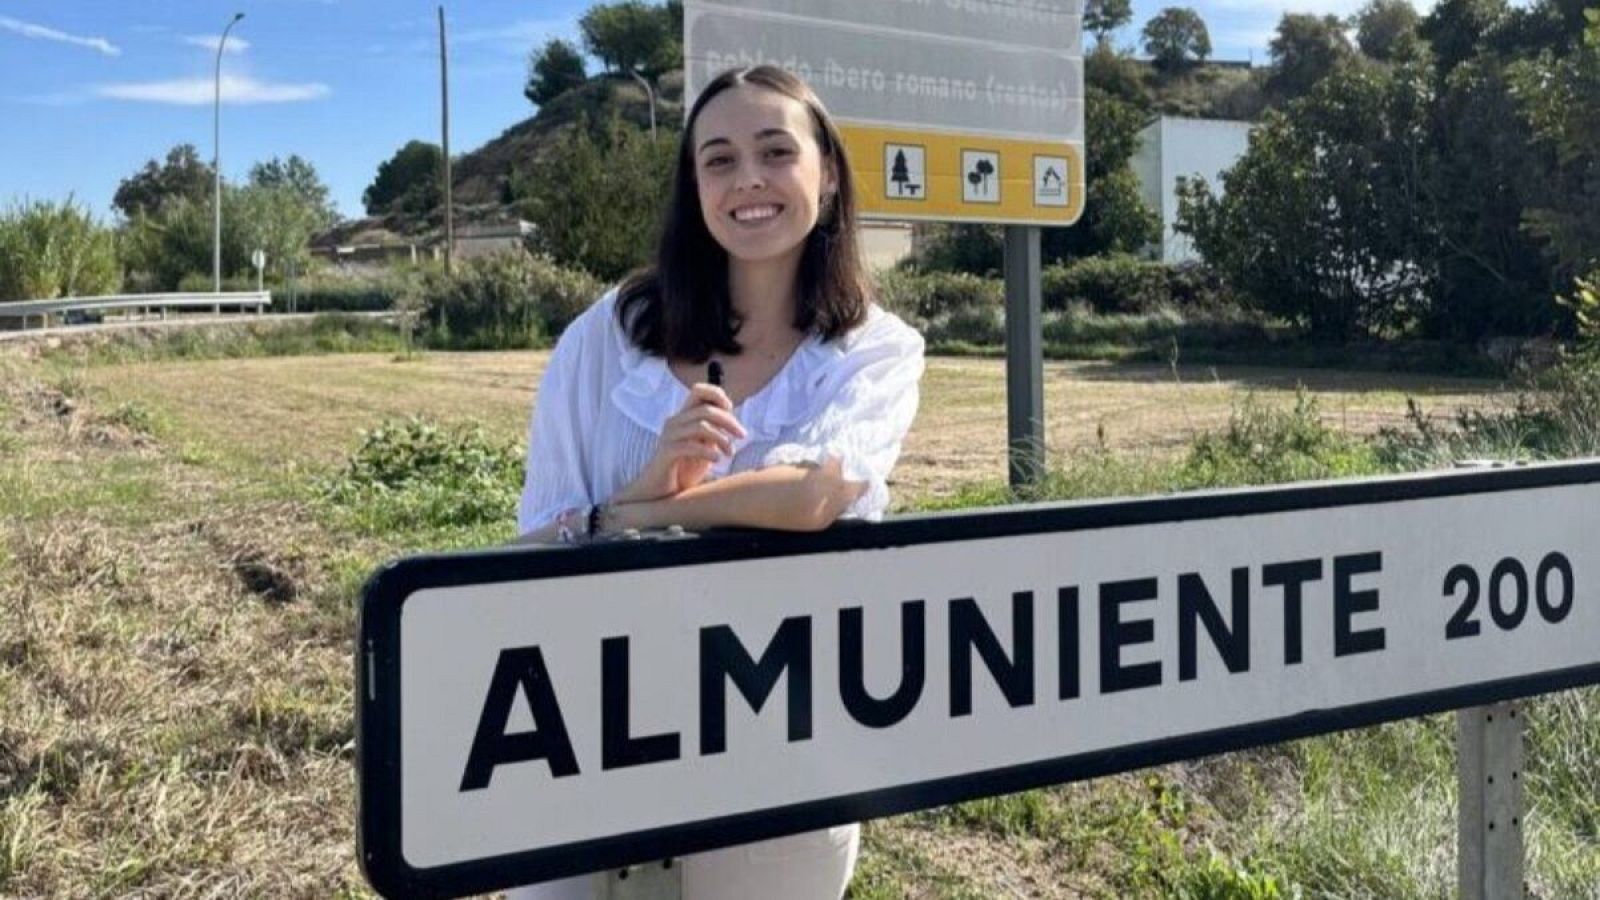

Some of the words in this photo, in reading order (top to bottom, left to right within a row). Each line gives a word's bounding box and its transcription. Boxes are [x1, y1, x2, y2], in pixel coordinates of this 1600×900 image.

[895, 71, 977, 100] romano
[459, 550, 1386, 793] ALMUNIENTE
[1443, 551, 1574, 640] 200
